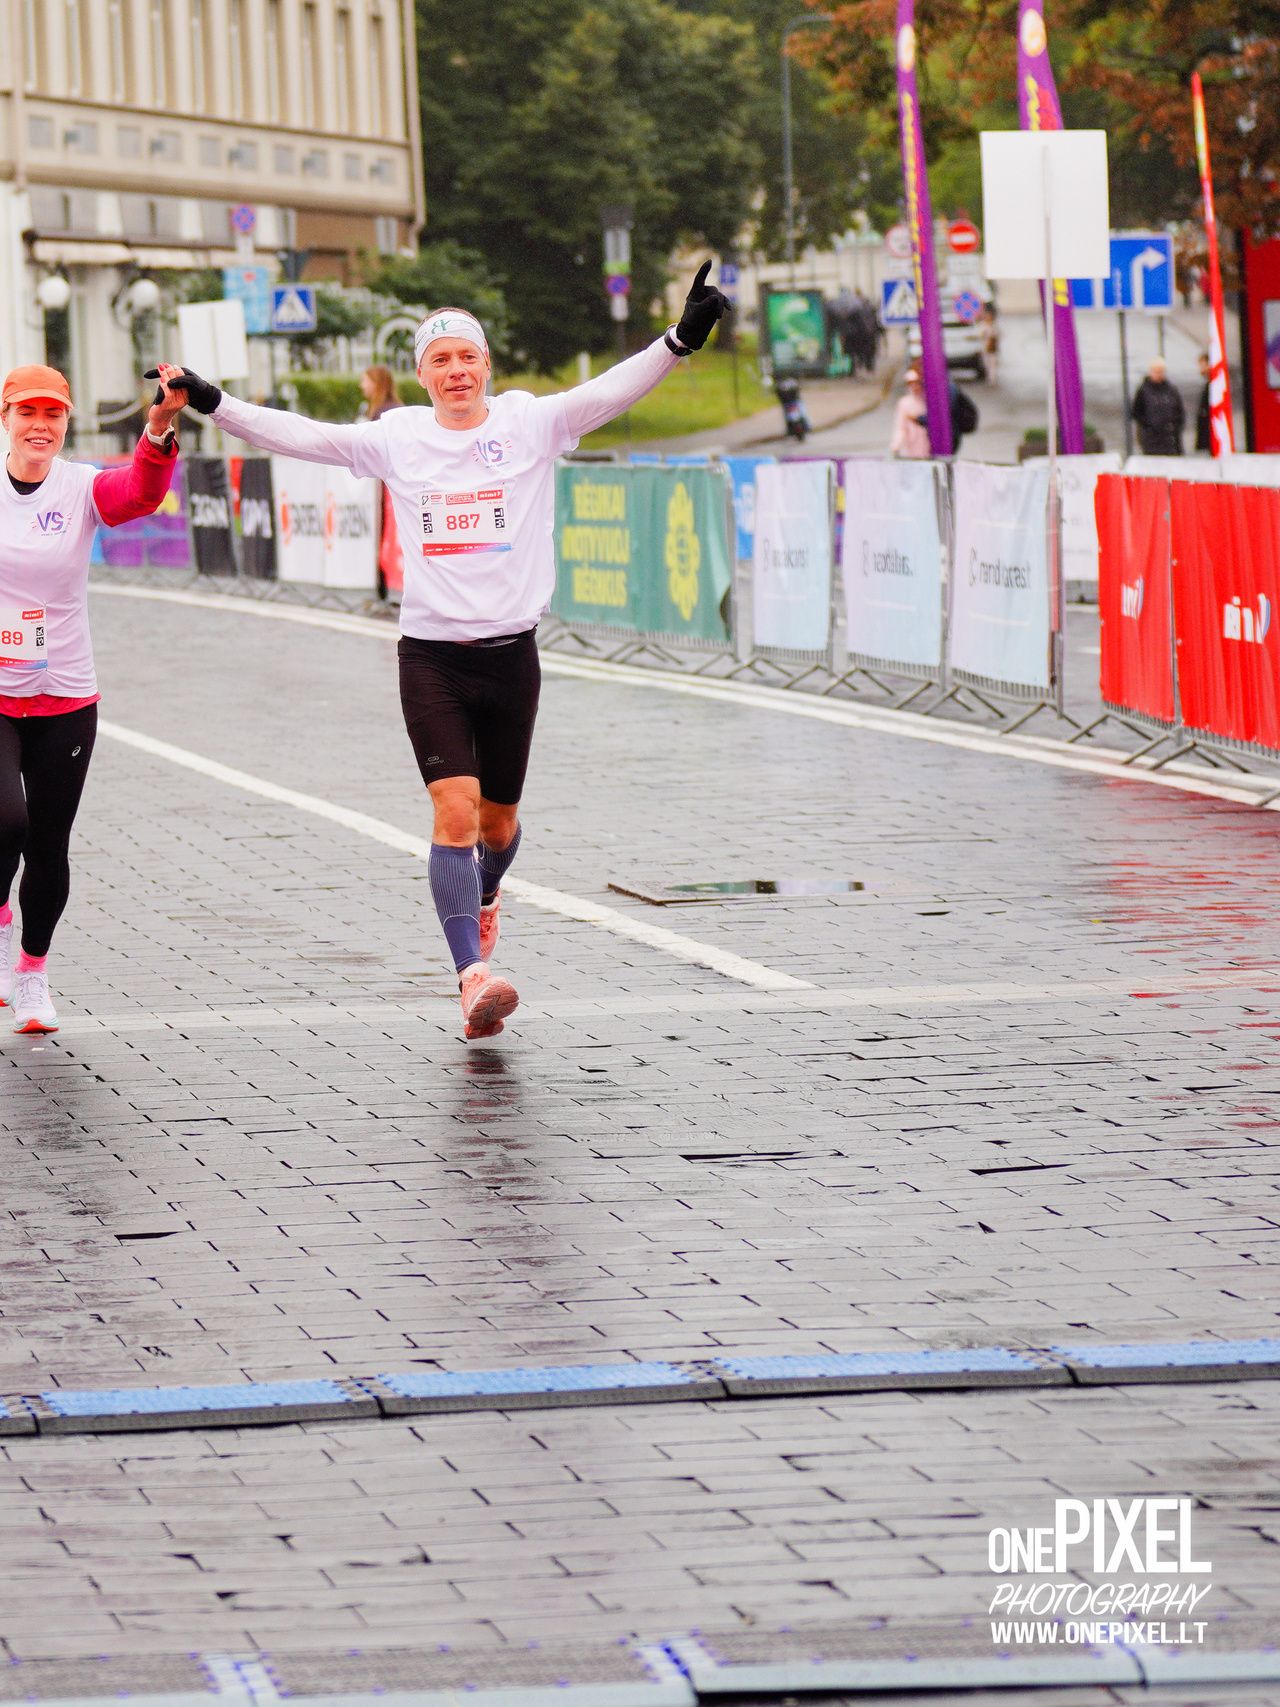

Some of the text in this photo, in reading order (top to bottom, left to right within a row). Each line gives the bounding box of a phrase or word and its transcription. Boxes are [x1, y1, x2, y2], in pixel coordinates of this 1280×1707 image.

[477, 440, 503, 463] VS
[37, 511, 64, 532] VS
[446, 514, 480, 530] 887
